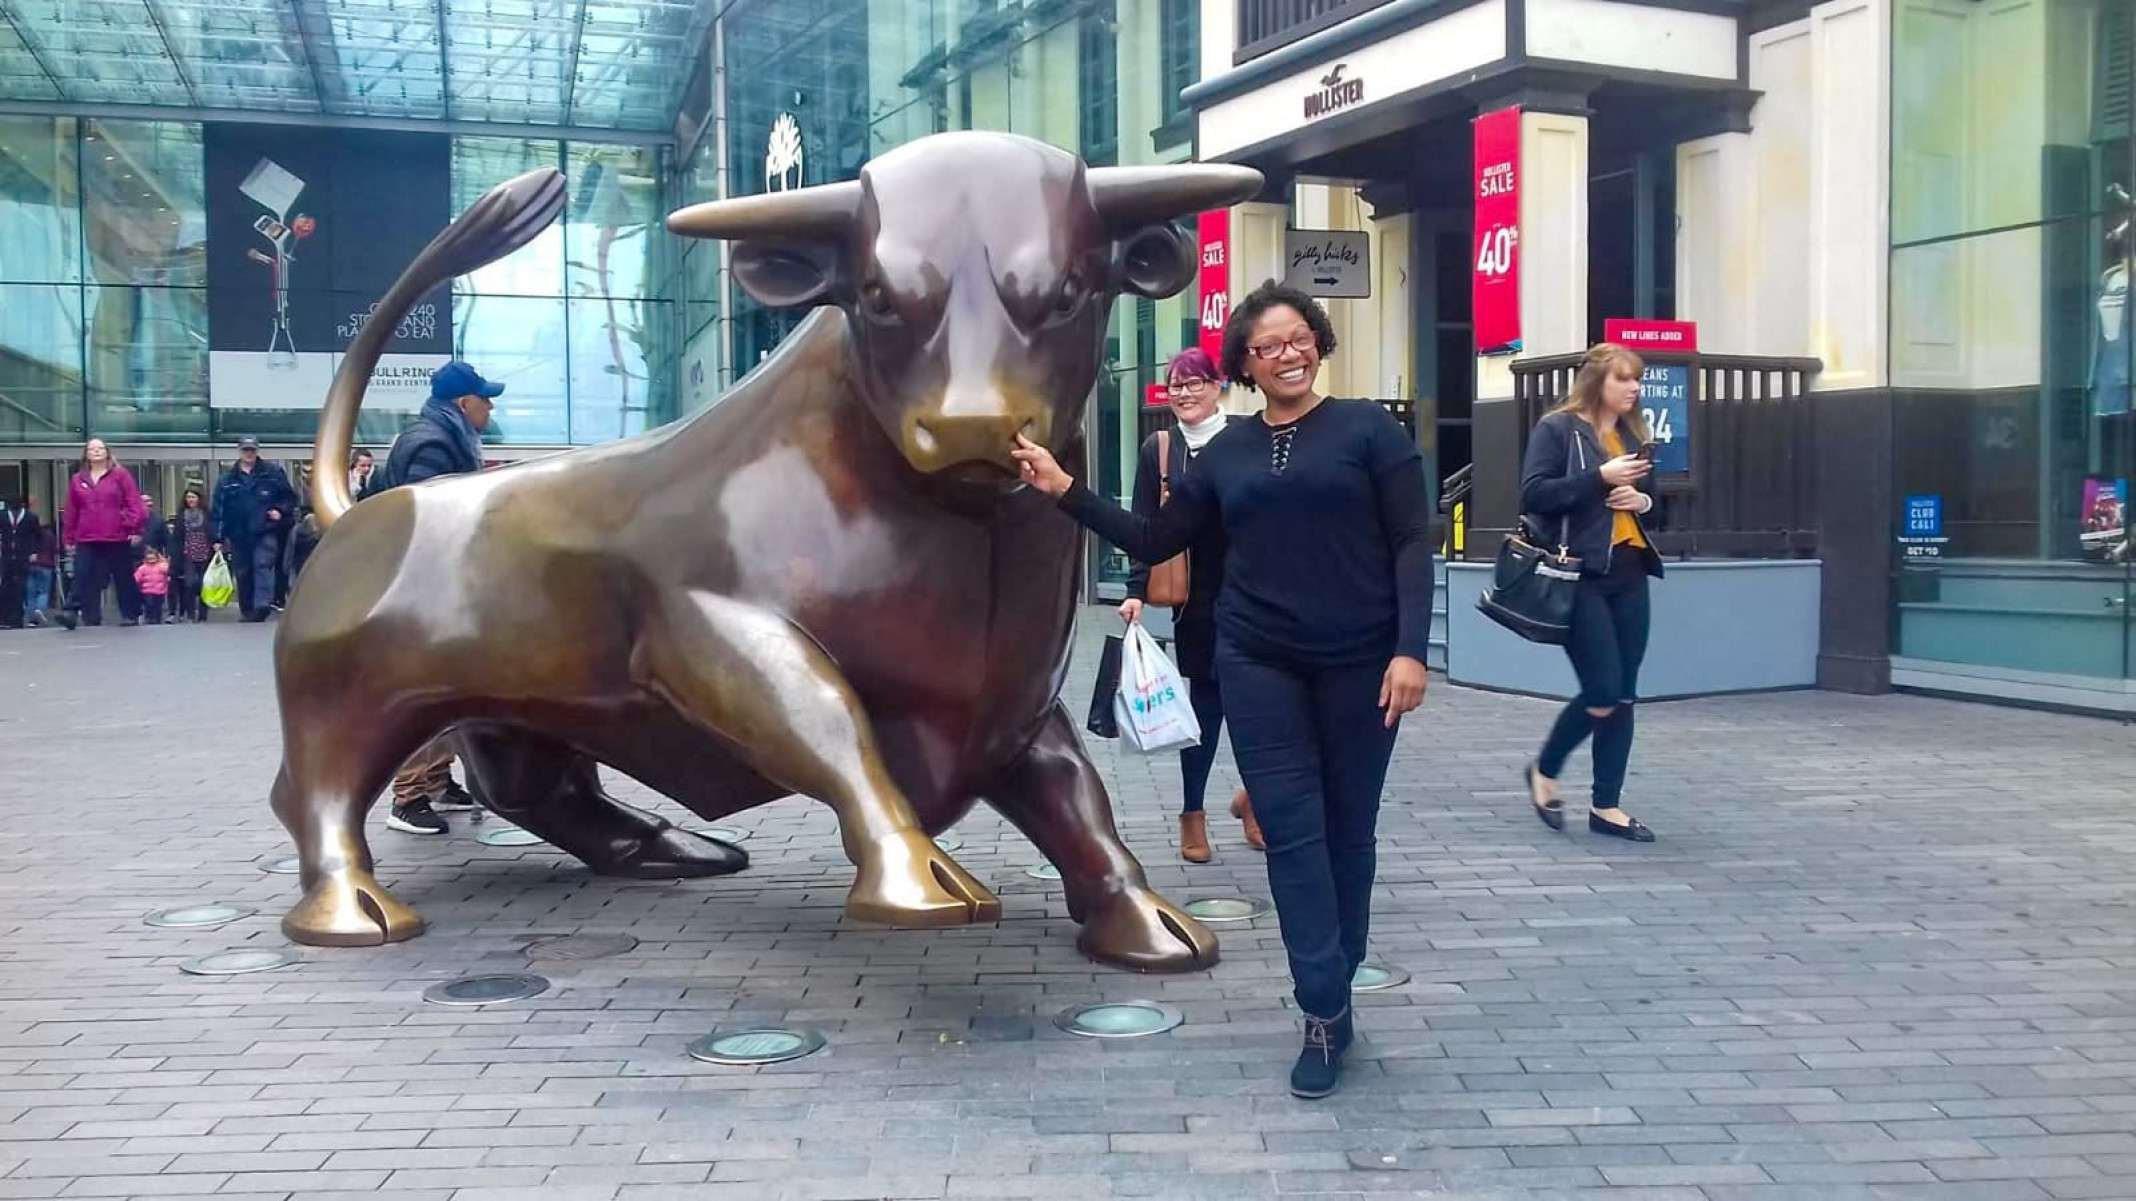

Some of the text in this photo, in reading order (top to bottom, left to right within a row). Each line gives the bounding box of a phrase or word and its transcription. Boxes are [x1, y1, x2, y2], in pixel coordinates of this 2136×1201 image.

[1304, 78, 1364, 118] HOLLISTER
[1480, 172, 1515, 197] SALE
[1202, 248, 1225, 268] SALE
[404, 314, 436, 328] AND
[413, 326, 436, 339] EAT
[1621, 330, 1683, 341] NEW LINES ADDED
[1643, 368, 1669, 382] EANS
[1640, 384, 1684, 400] RTING AT
